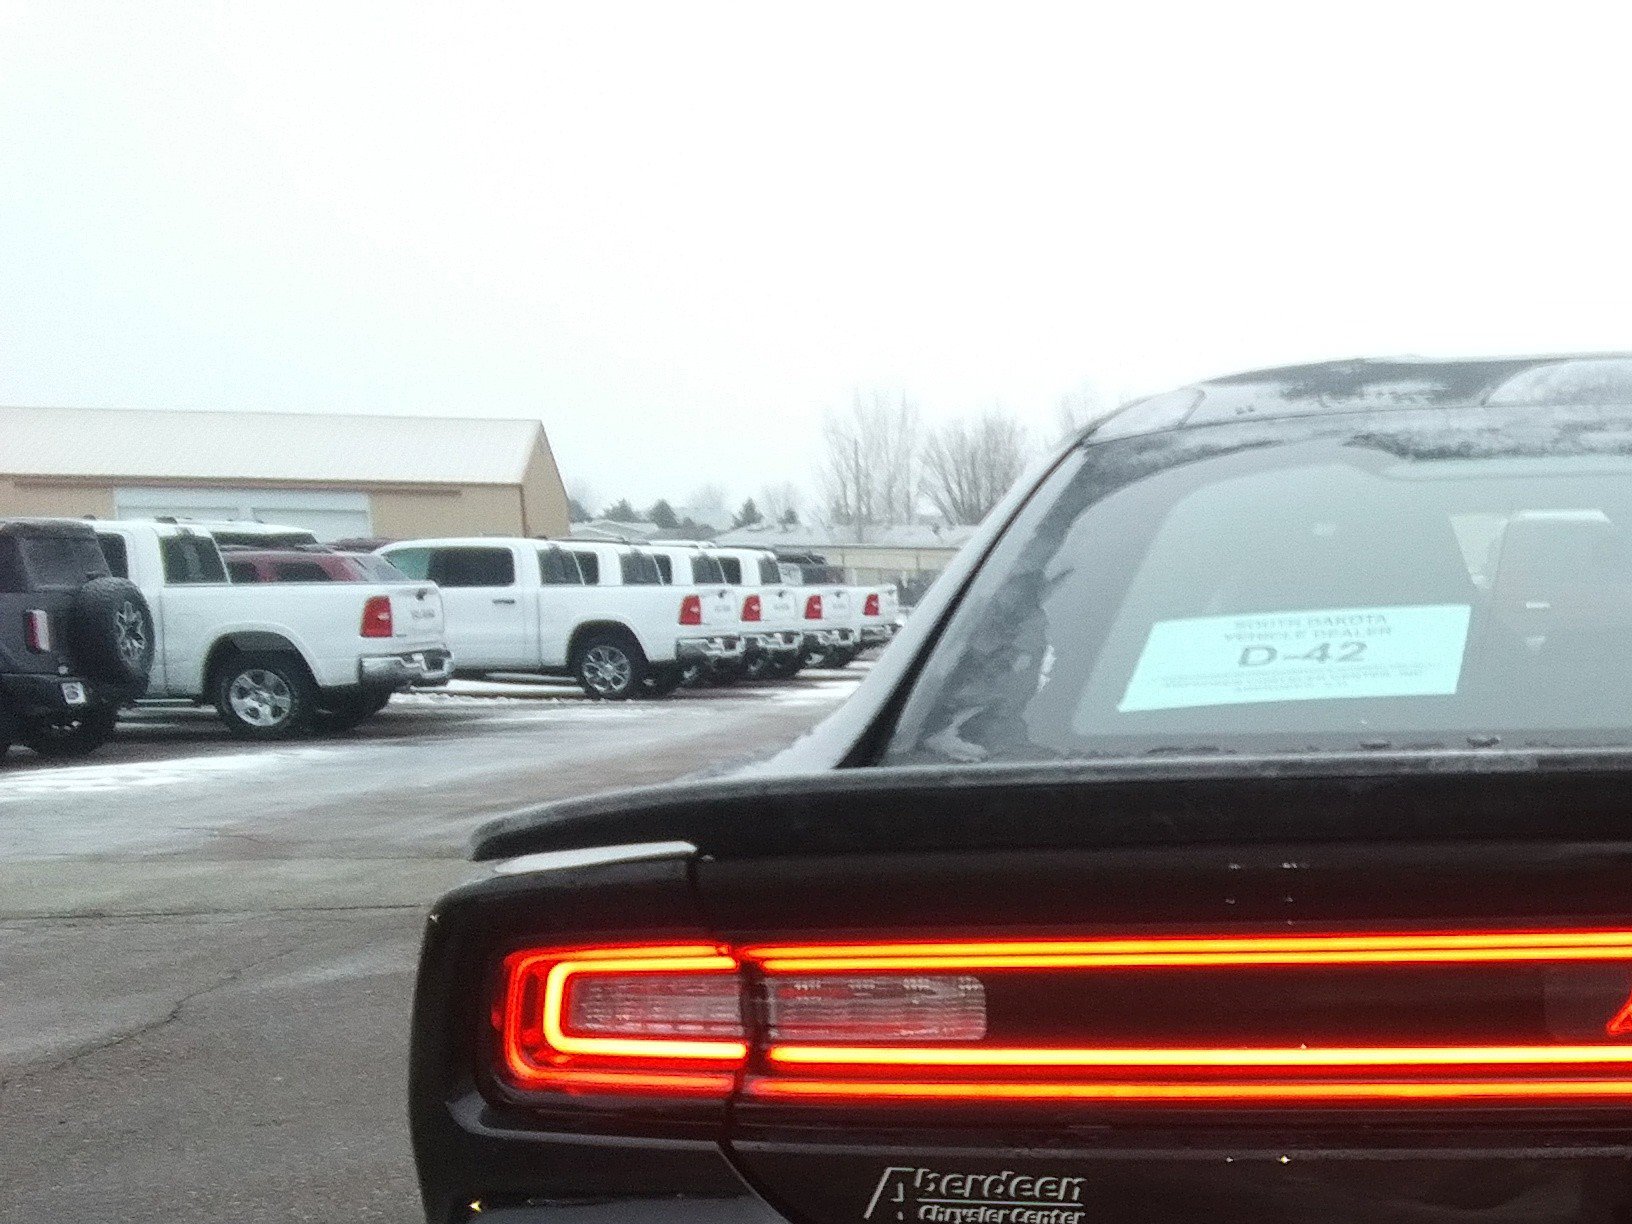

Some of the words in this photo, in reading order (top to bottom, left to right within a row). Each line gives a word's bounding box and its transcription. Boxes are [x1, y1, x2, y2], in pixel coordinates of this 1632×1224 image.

[1238, 641, 1369, 668] D-42
[863, 1166, 1088, 1221] Aberdeen
[918, 1204, 1010, 1224] Chrysler
